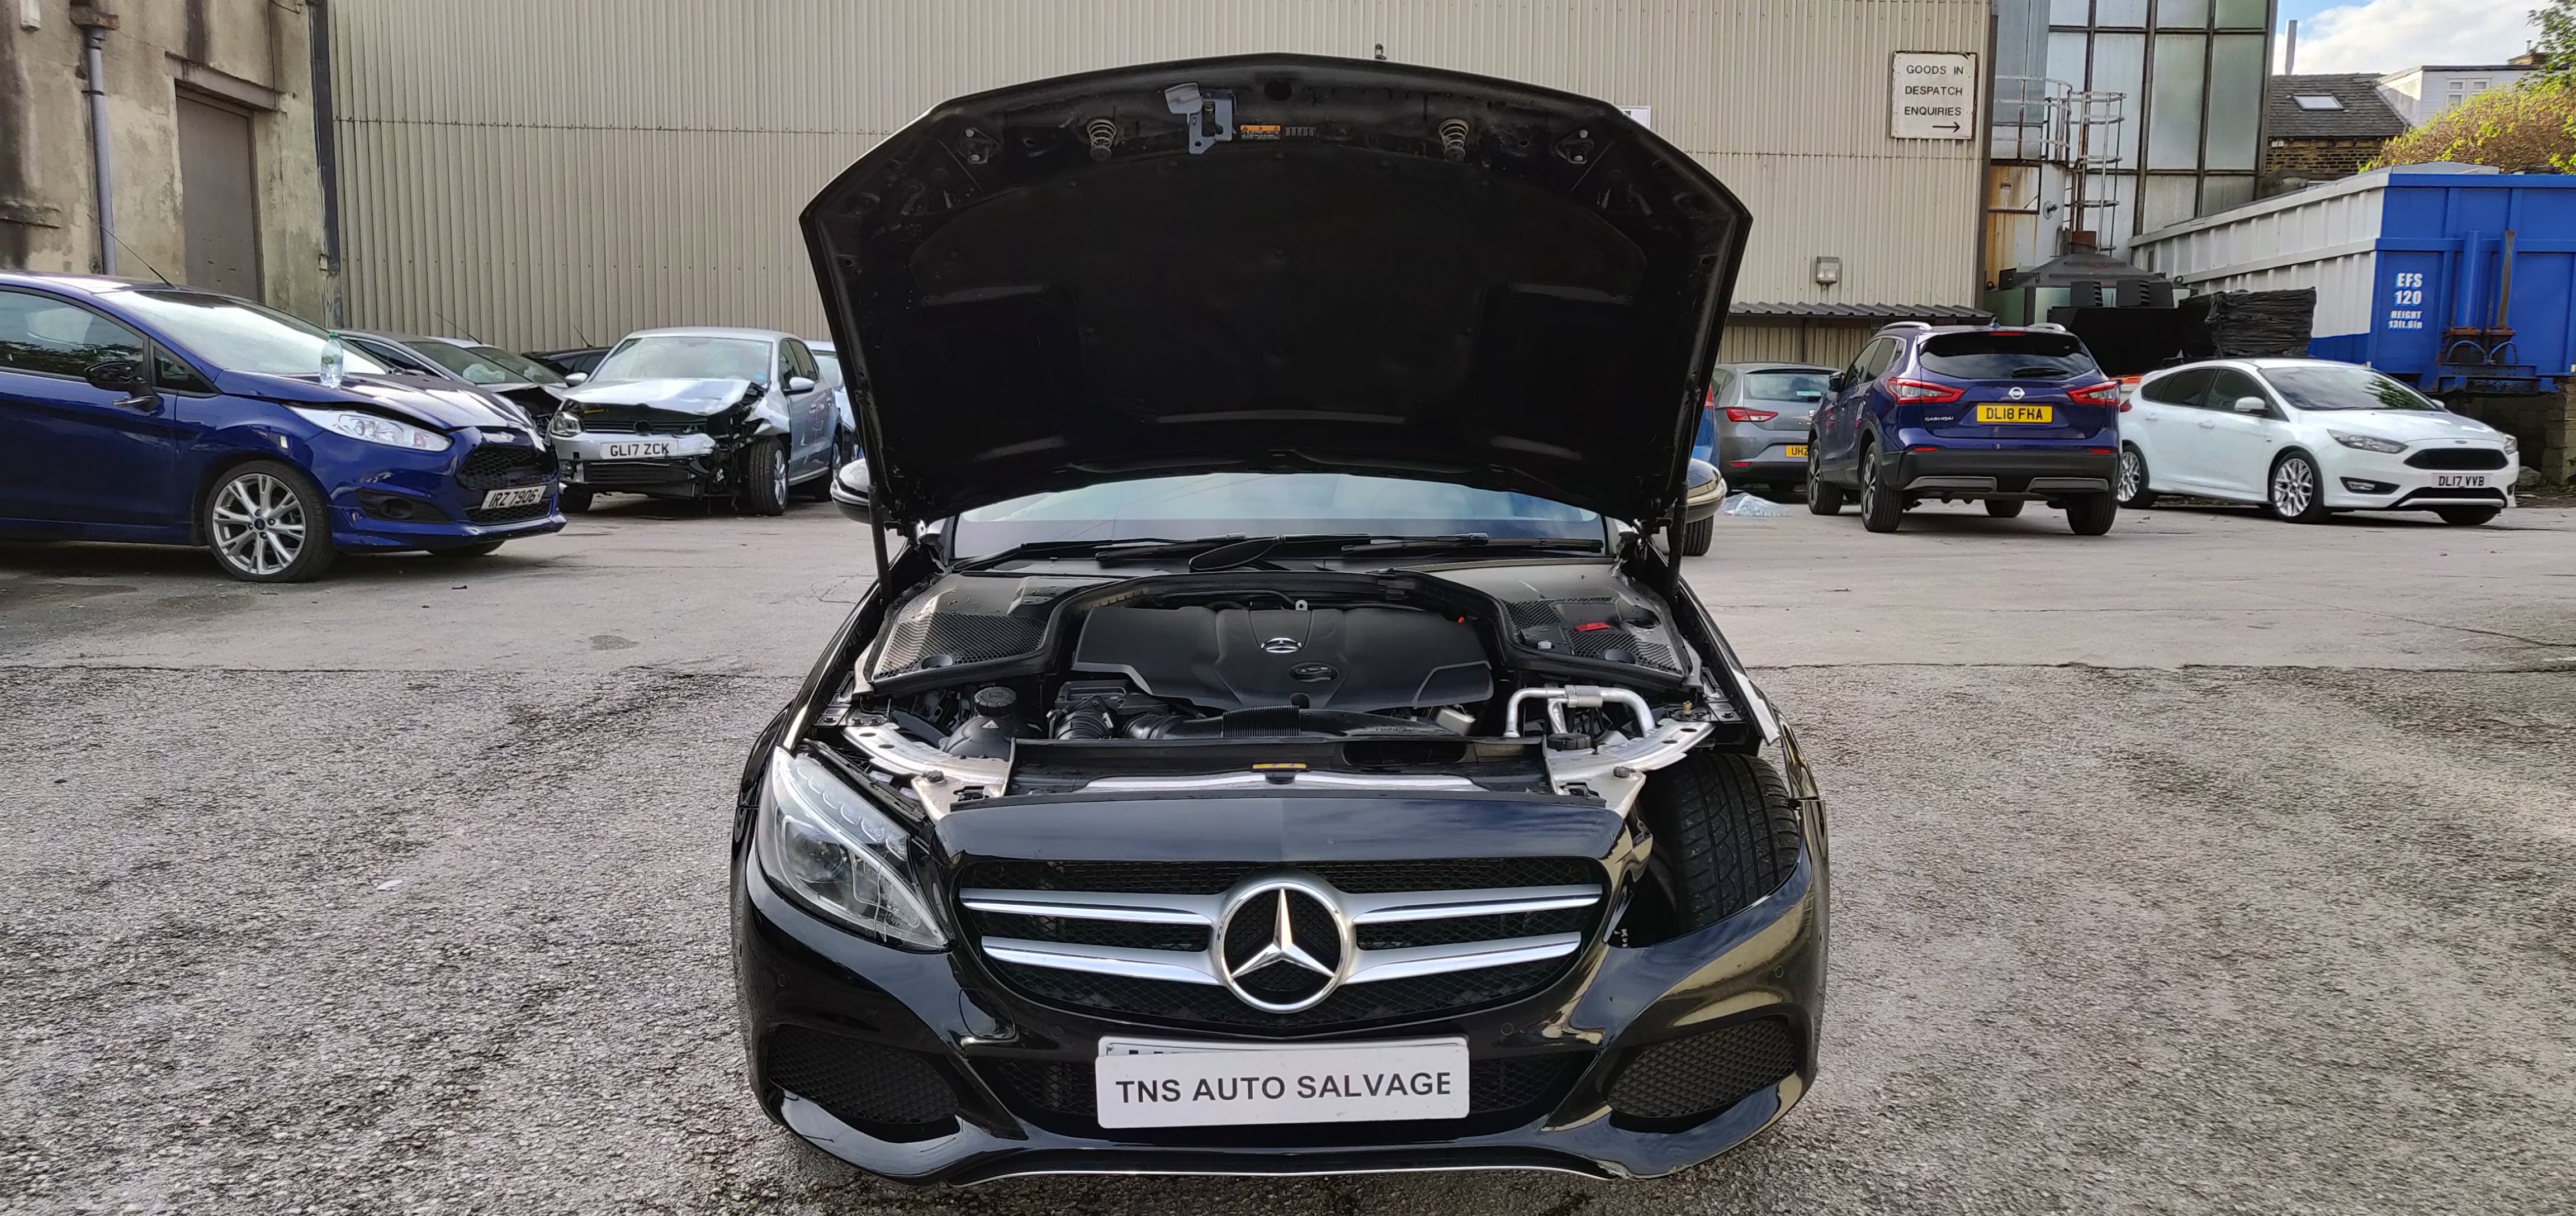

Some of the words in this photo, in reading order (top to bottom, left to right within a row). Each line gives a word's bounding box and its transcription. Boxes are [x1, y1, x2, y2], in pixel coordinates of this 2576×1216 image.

[1906, 65, 1947, 74] GOODS
[1954, 66, 1964, 75] IN
[1905, 86, 1963, 96] DESPATCH
[1904, 106, 1962, 116] ENQUIRIES
[2396, 273, 2423, 288] EFS
[2394, 290, 2422, 305] 120
[2390, 310, 2422, 319] HEIGHT
[1986, 407, 2014, 420] DL18
[2018, 408, 2043, 420] FHA
[610, 444, 640, 457] GL17
[643, 443, 670, 455] ZCK
[2438, 476, 2463, 486] DL17
[2465, 476, 2484, 486] VVB
[488, 492, 511, 507] IRZ
[509, 489, 539, 505] 7906
[1116, 1080, 1181, 1103] TNS
[1192, 1076, 1285, 1101] AUTO
[1296, 1072, 1451, 1099] SALVAGE
